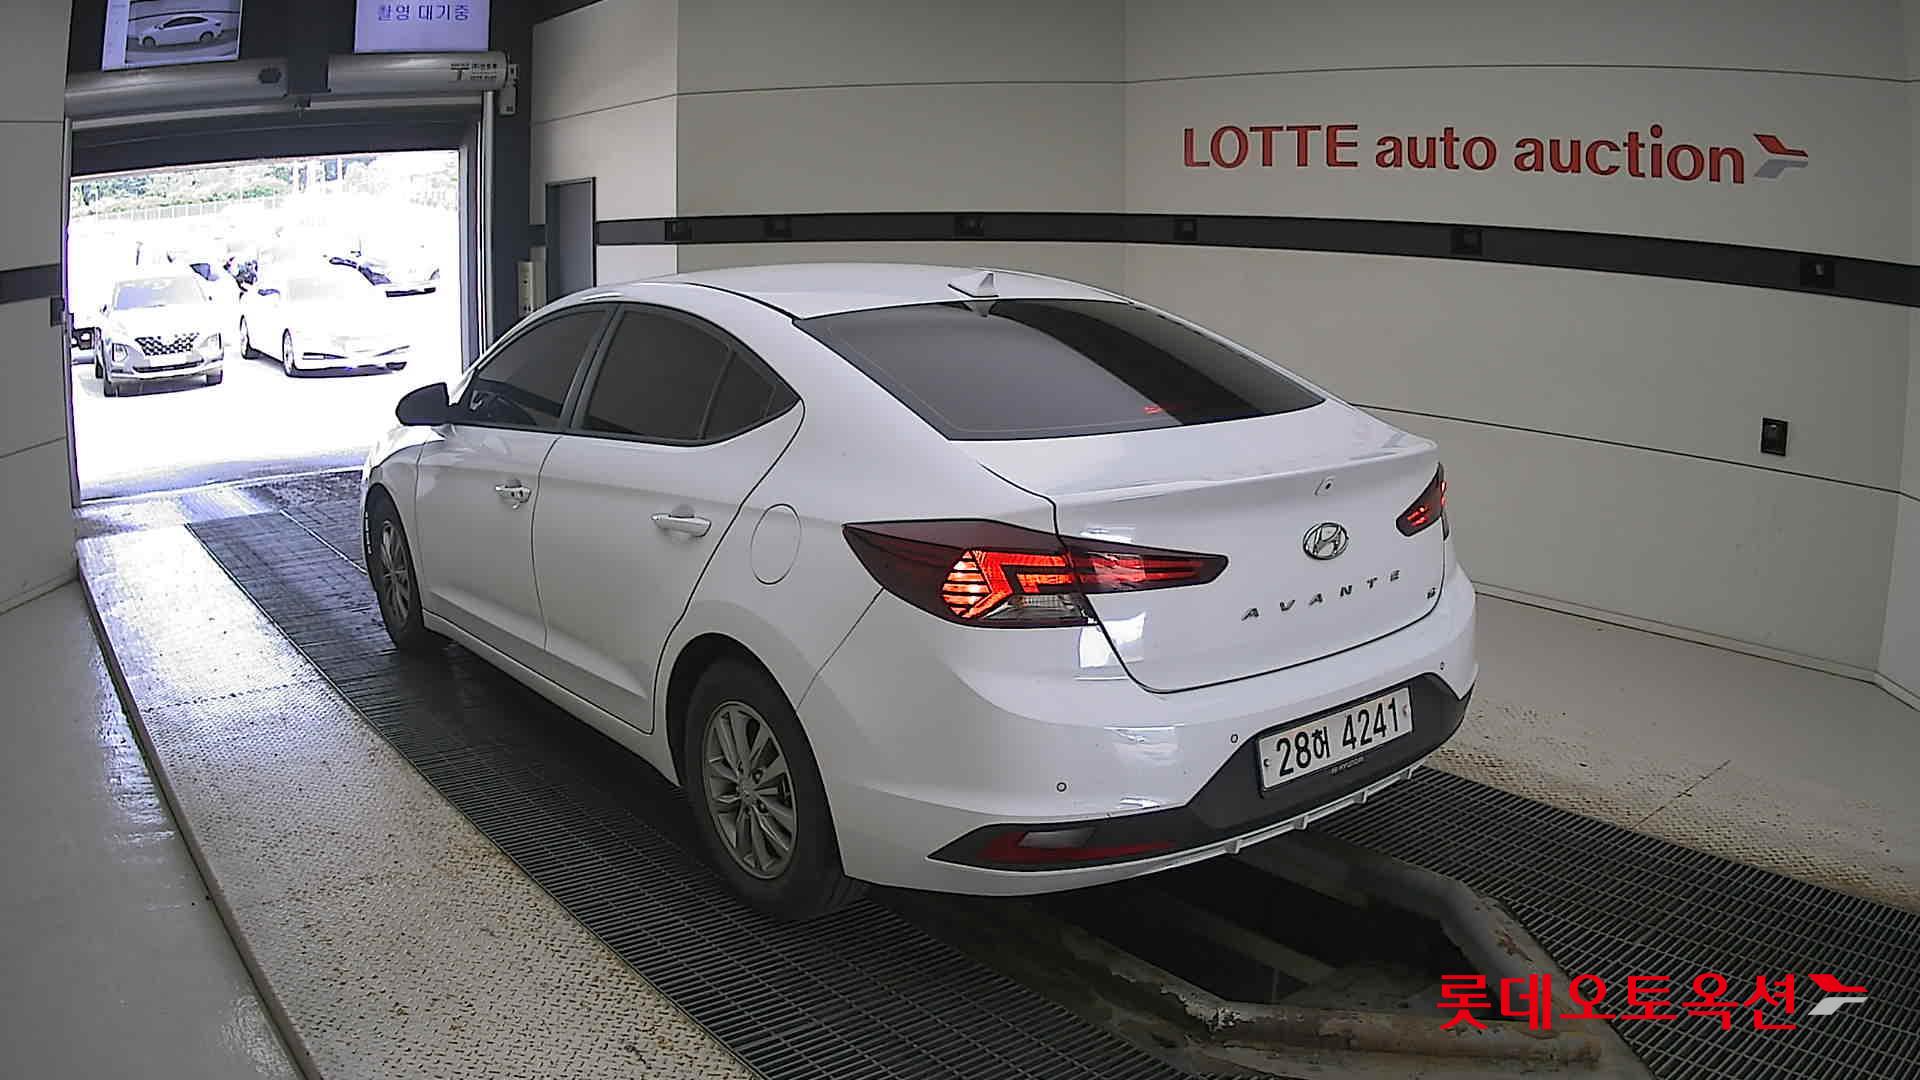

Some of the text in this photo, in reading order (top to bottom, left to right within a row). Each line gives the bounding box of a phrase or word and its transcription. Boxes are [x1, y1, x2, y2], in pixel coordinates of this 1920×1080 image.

[418, 4, 470, 21] 대기중
[1184, 124, 1744, 184] LOTTE auto auction
[1241, 569, 1401, 621] AVANTE
[1276, 697, 1398, 777] 28허 4241
